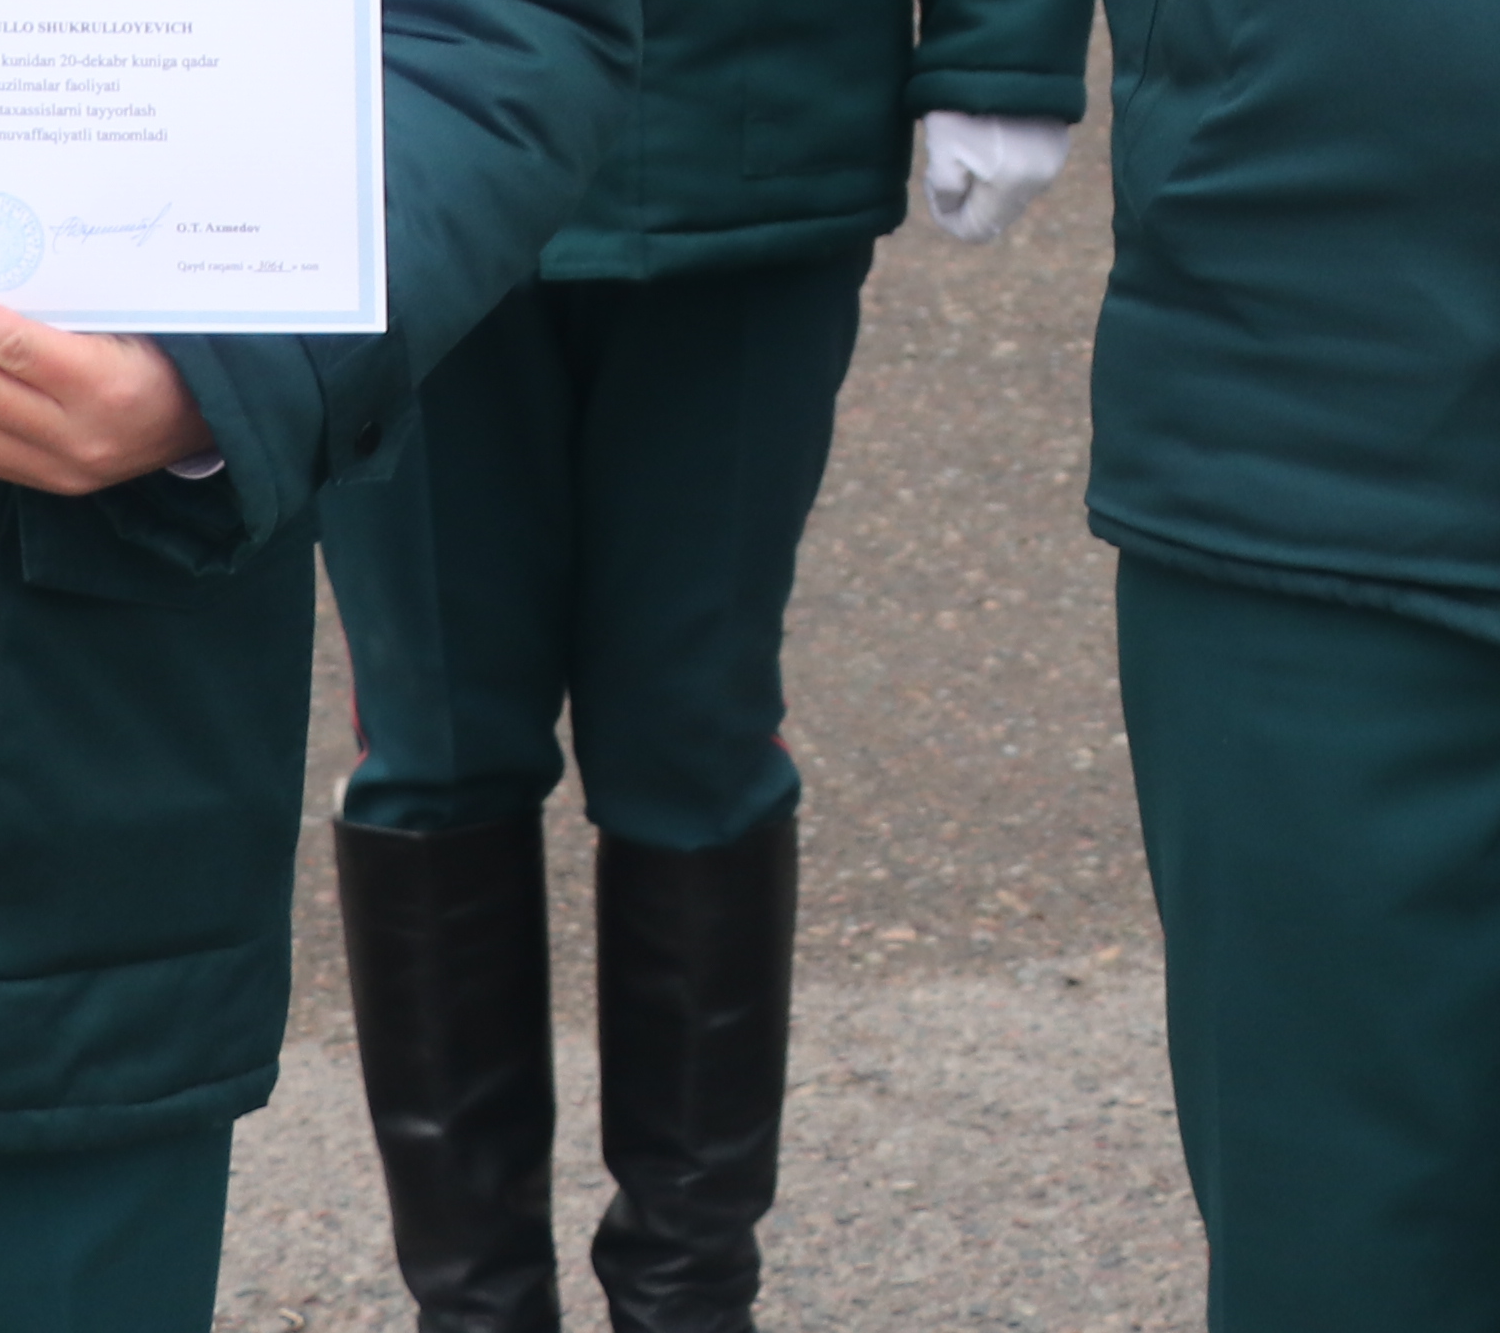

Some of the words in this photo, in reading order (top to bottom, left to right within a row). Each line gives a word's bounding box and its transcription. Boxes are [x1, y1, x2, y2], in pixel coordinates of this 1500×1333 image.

[38, 22, 192, 35] SHUKRULLOYEVICH
[1, 53, 56, 68] kunidan
[60, 54, 128, 69] 20-dekabr
[132, 54, 178, 72] kuniga
[181, 54, 219, 72] qadar
[65, 78, 120, 96] faoliyati
[86, 103, 156, 121] tayyorlash
[96, 128, 168, 143] tamomladi
[206, 222, 260, 234] Axmedov
